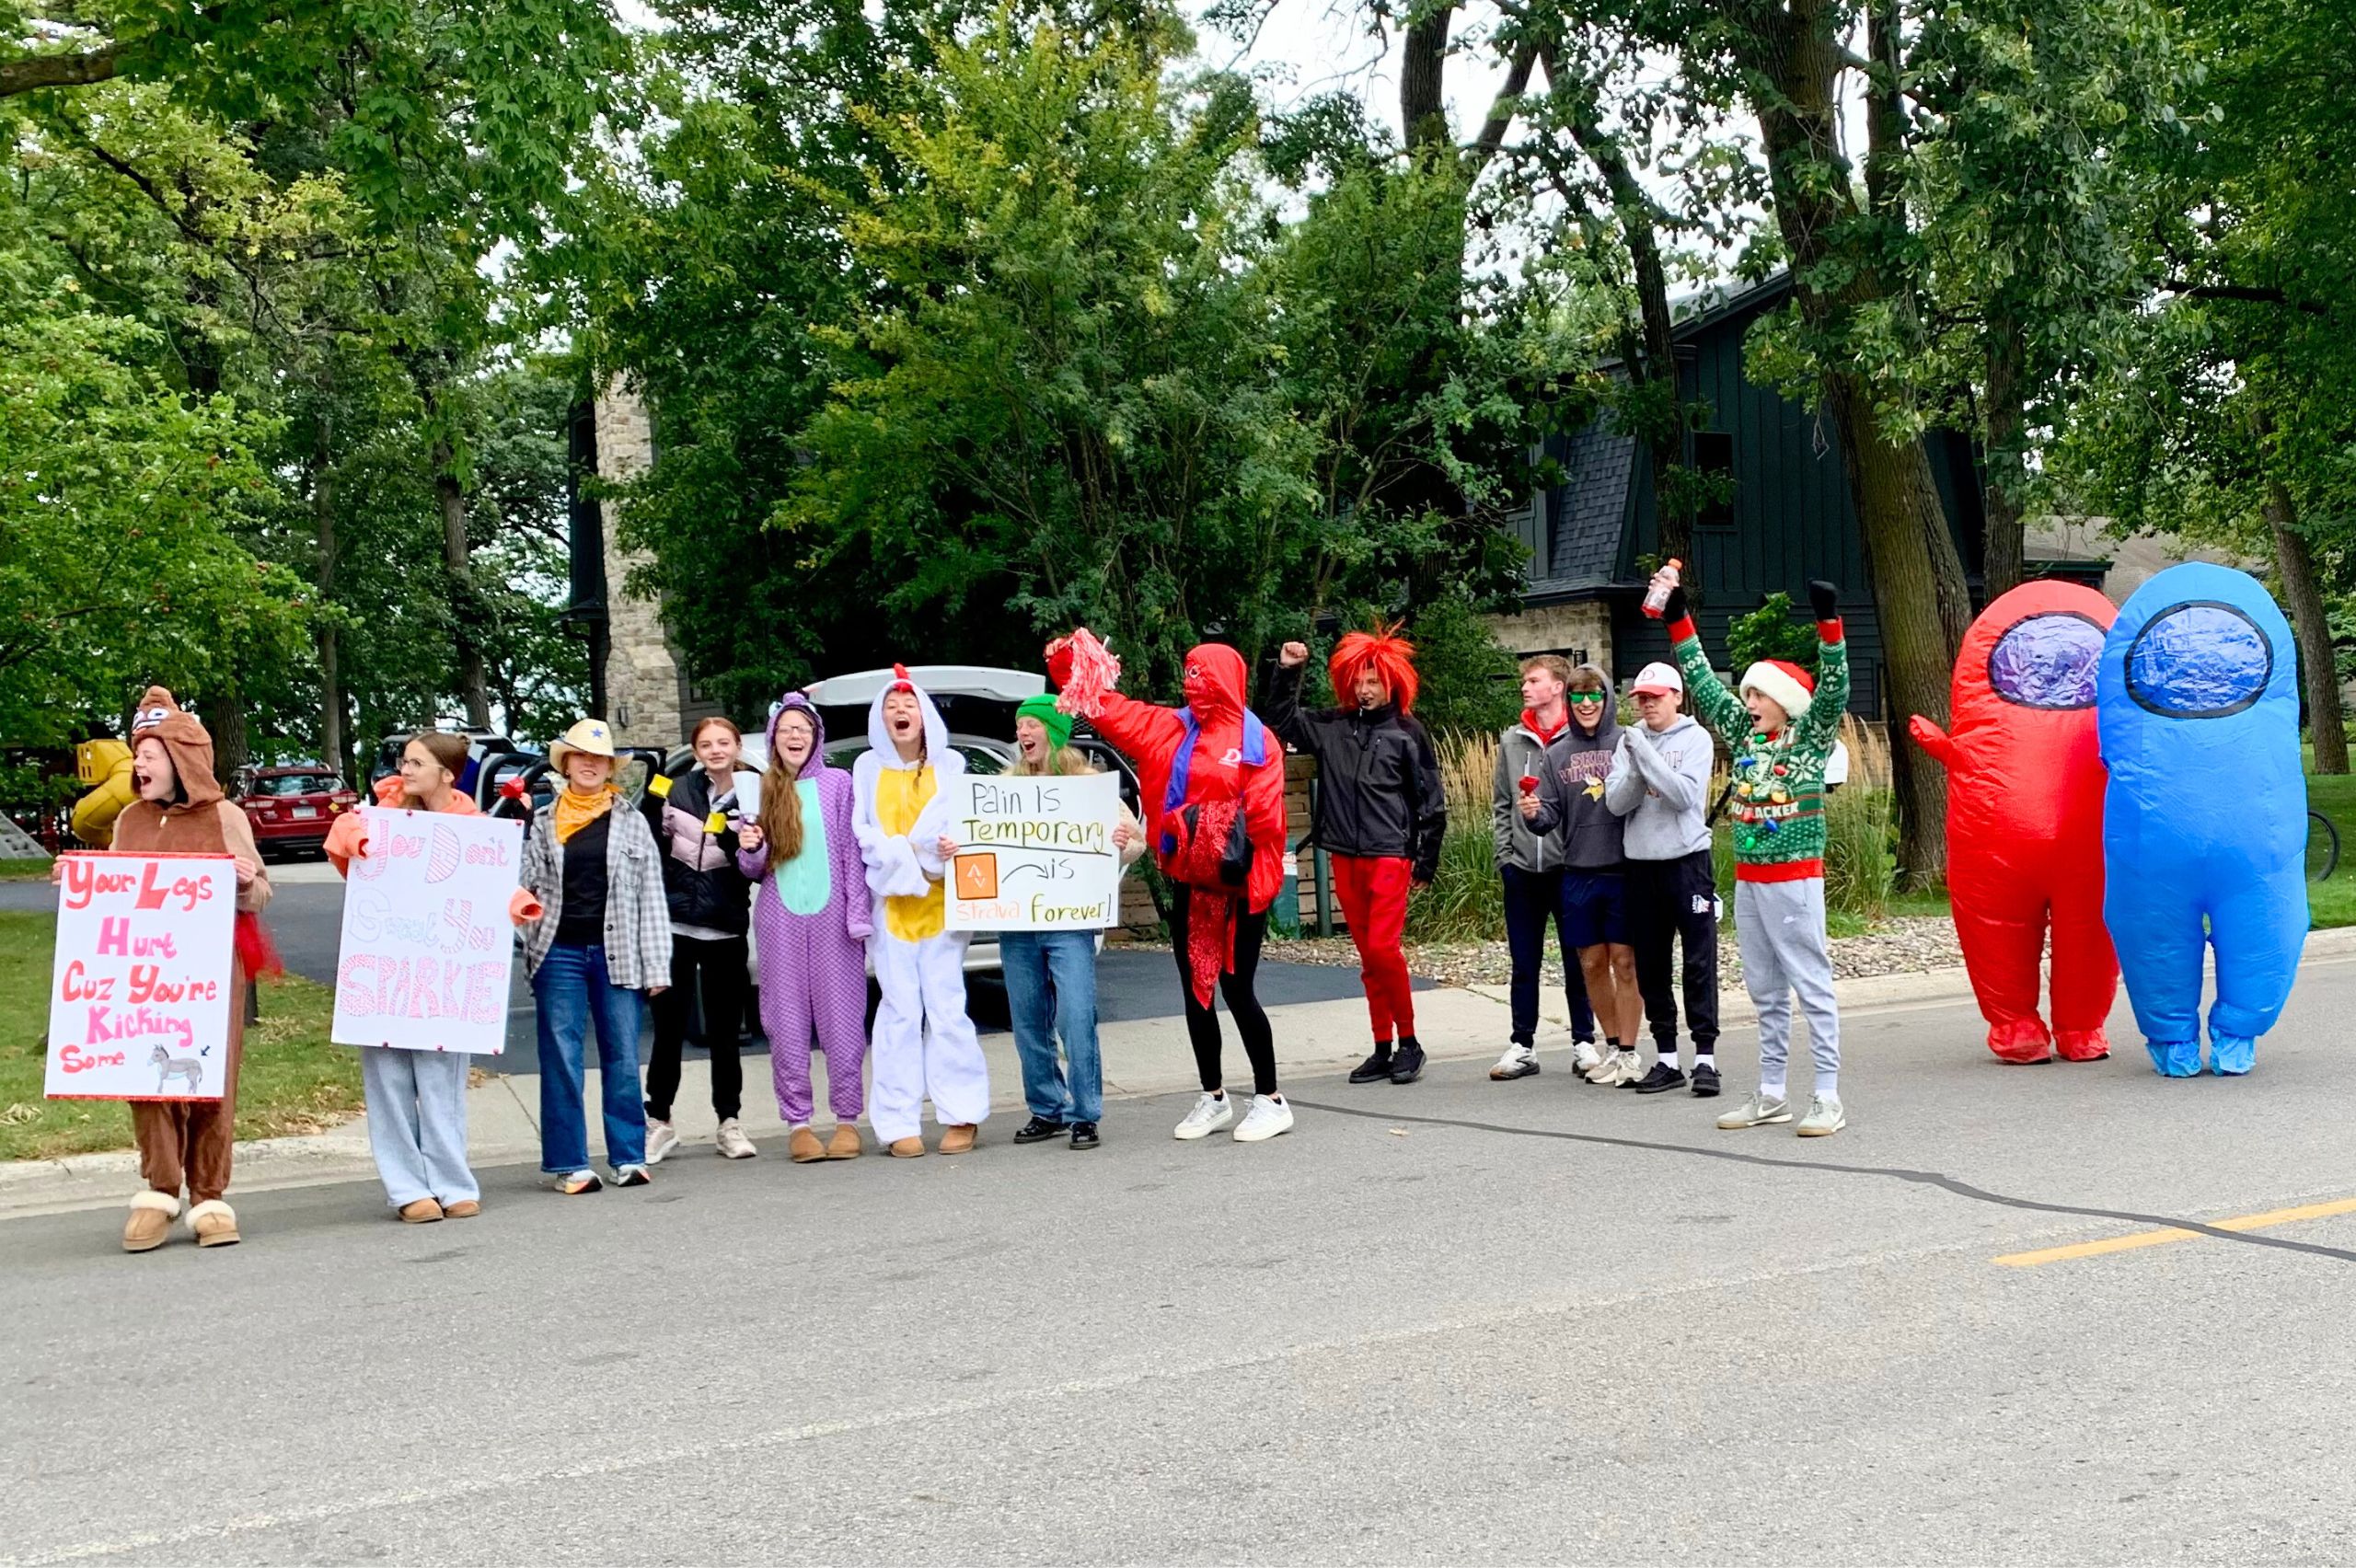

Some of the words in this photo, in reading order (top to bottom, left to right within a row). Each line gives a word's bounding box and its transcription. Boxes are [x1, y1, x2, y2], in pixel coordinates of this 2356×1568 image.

[972, 782, 1022, 814] Pain
[355, 817, 426, 882] You
[424, 823, 509, 884] Don't
[962, 819, 1103, 854] Temporary
[65, 859, 136, 910] Your
[134, 861, 214, 912] Legs
[96, 916, 178, 959] Hurt
[62, 959, 117, 1003] Cuz
[127, 964, 217, 1005] You're
[85, 1005, 194, 1048] Kicking
[59, 1043, 126, 1074] Some
